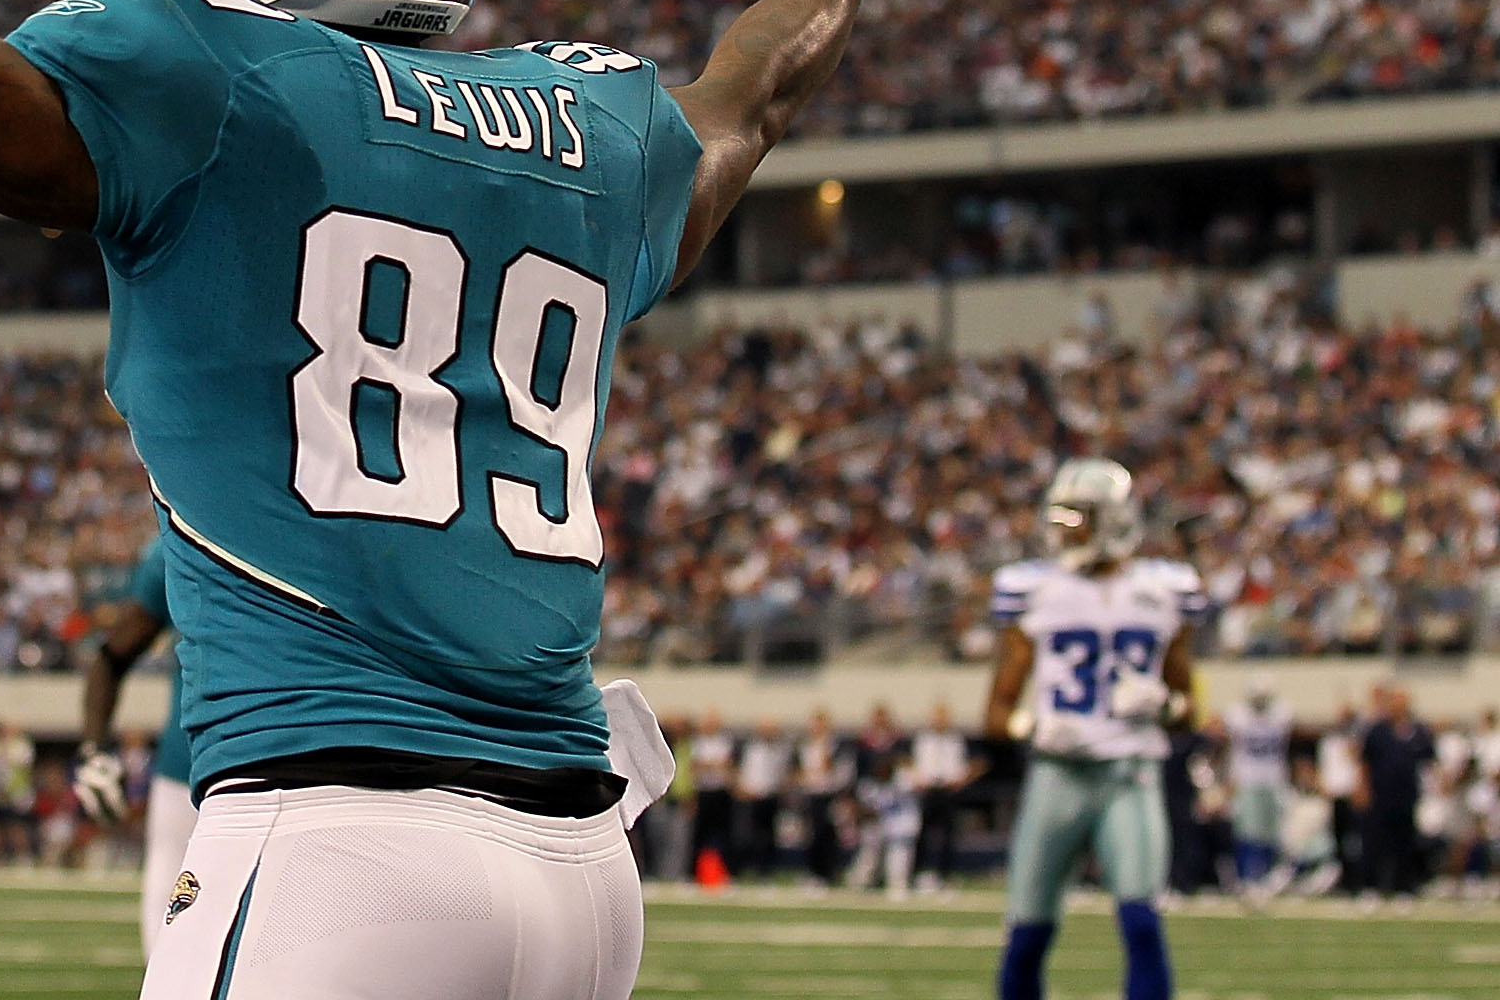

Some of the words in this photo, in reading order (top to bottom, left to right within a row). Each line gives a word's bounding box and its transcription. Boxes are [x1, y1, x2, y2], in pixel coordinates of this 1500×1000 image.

[373, 9, 453, 33] JAGUARS
[395, 2, 450, 14] JACKSONVILLE
[357, 42, 587, 171] LEWIS
[287, 204, 608, 573] 89
